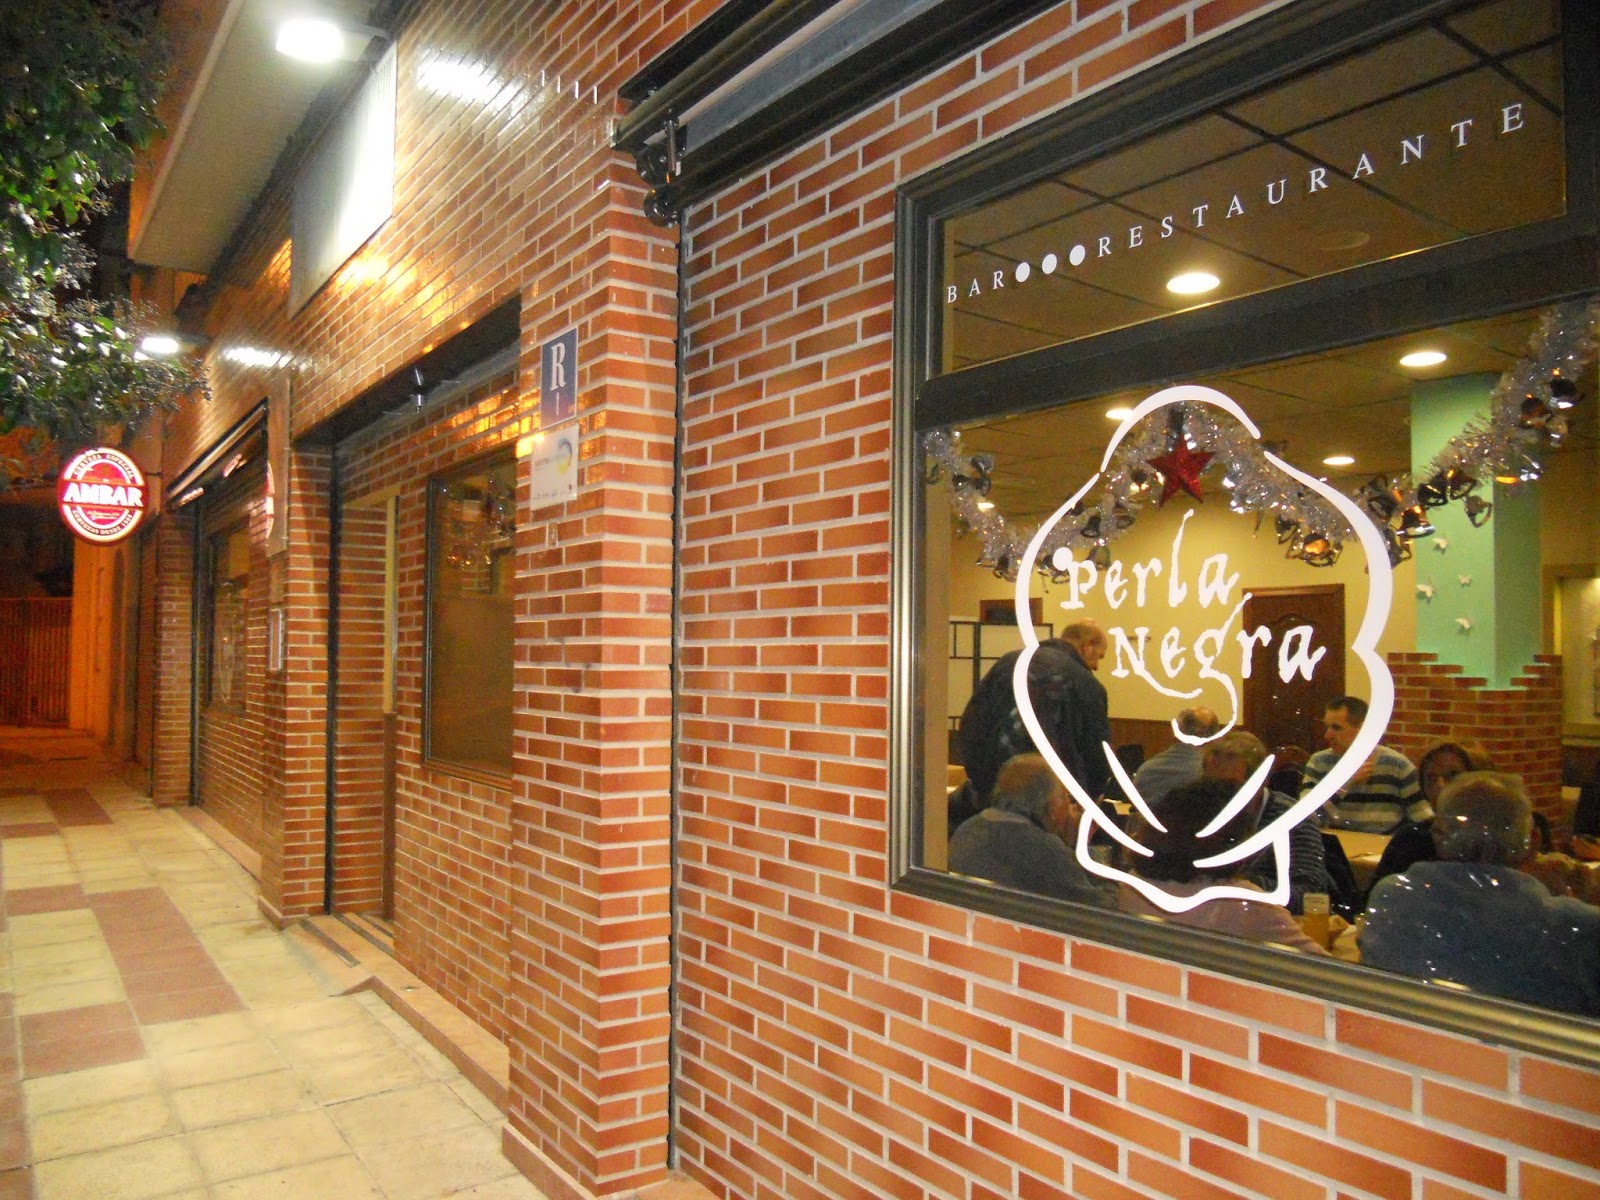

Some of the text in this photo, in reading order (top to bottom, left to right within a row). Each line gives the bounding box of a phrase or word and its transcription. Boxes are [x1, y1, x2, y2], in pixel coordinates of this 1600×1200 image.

[947, 103, 1526, 304] BAR RESTAURANTE
[551, 342, 567, 391] R
[63, 482, 144, 507] AMBAR
[1053, 509, 1240, 610] Perla
[1108, 592, 1327, 746] Negra
